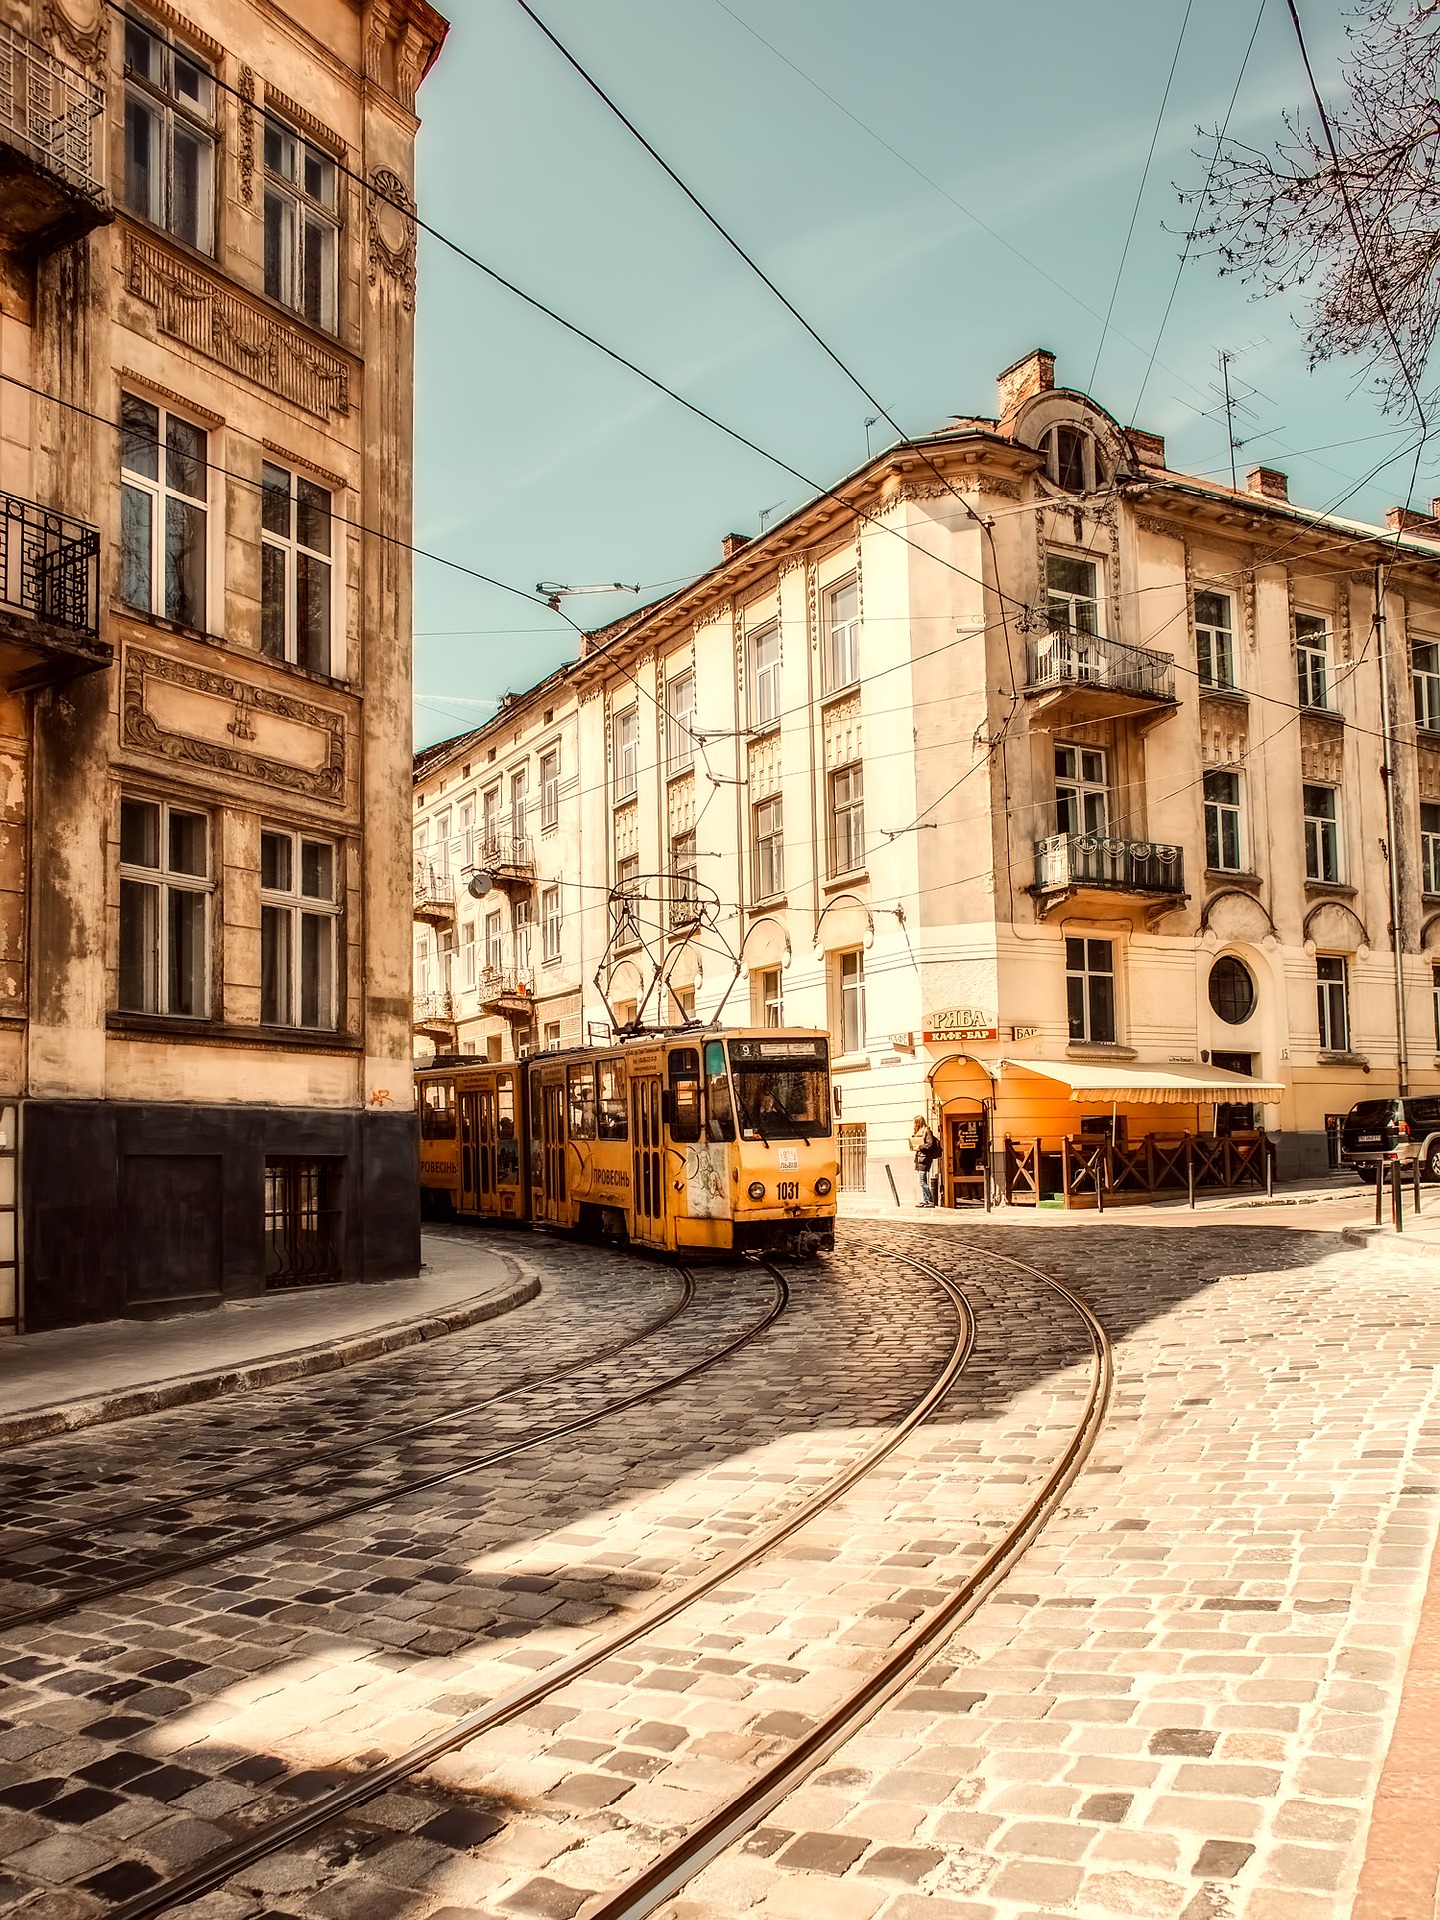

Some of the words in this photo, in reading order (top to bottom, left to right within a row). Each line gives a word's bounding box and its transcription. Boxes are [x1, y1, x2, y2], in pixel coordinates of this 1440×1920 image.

[933, 1010, 986, 1028] РЯБА
[931, 1031, 990, 1041] КАФЕ-БАР
[742, 1045, 750, 1056] 9
[1281, 1048, 1289, 1060] 15
[420, 1160, 457, 1174] РОВЕСІНЬ
[593, 1168, 630, 1188] ПРОВЕСІНЬ
[776, 1181, 799, 1200] 1031
